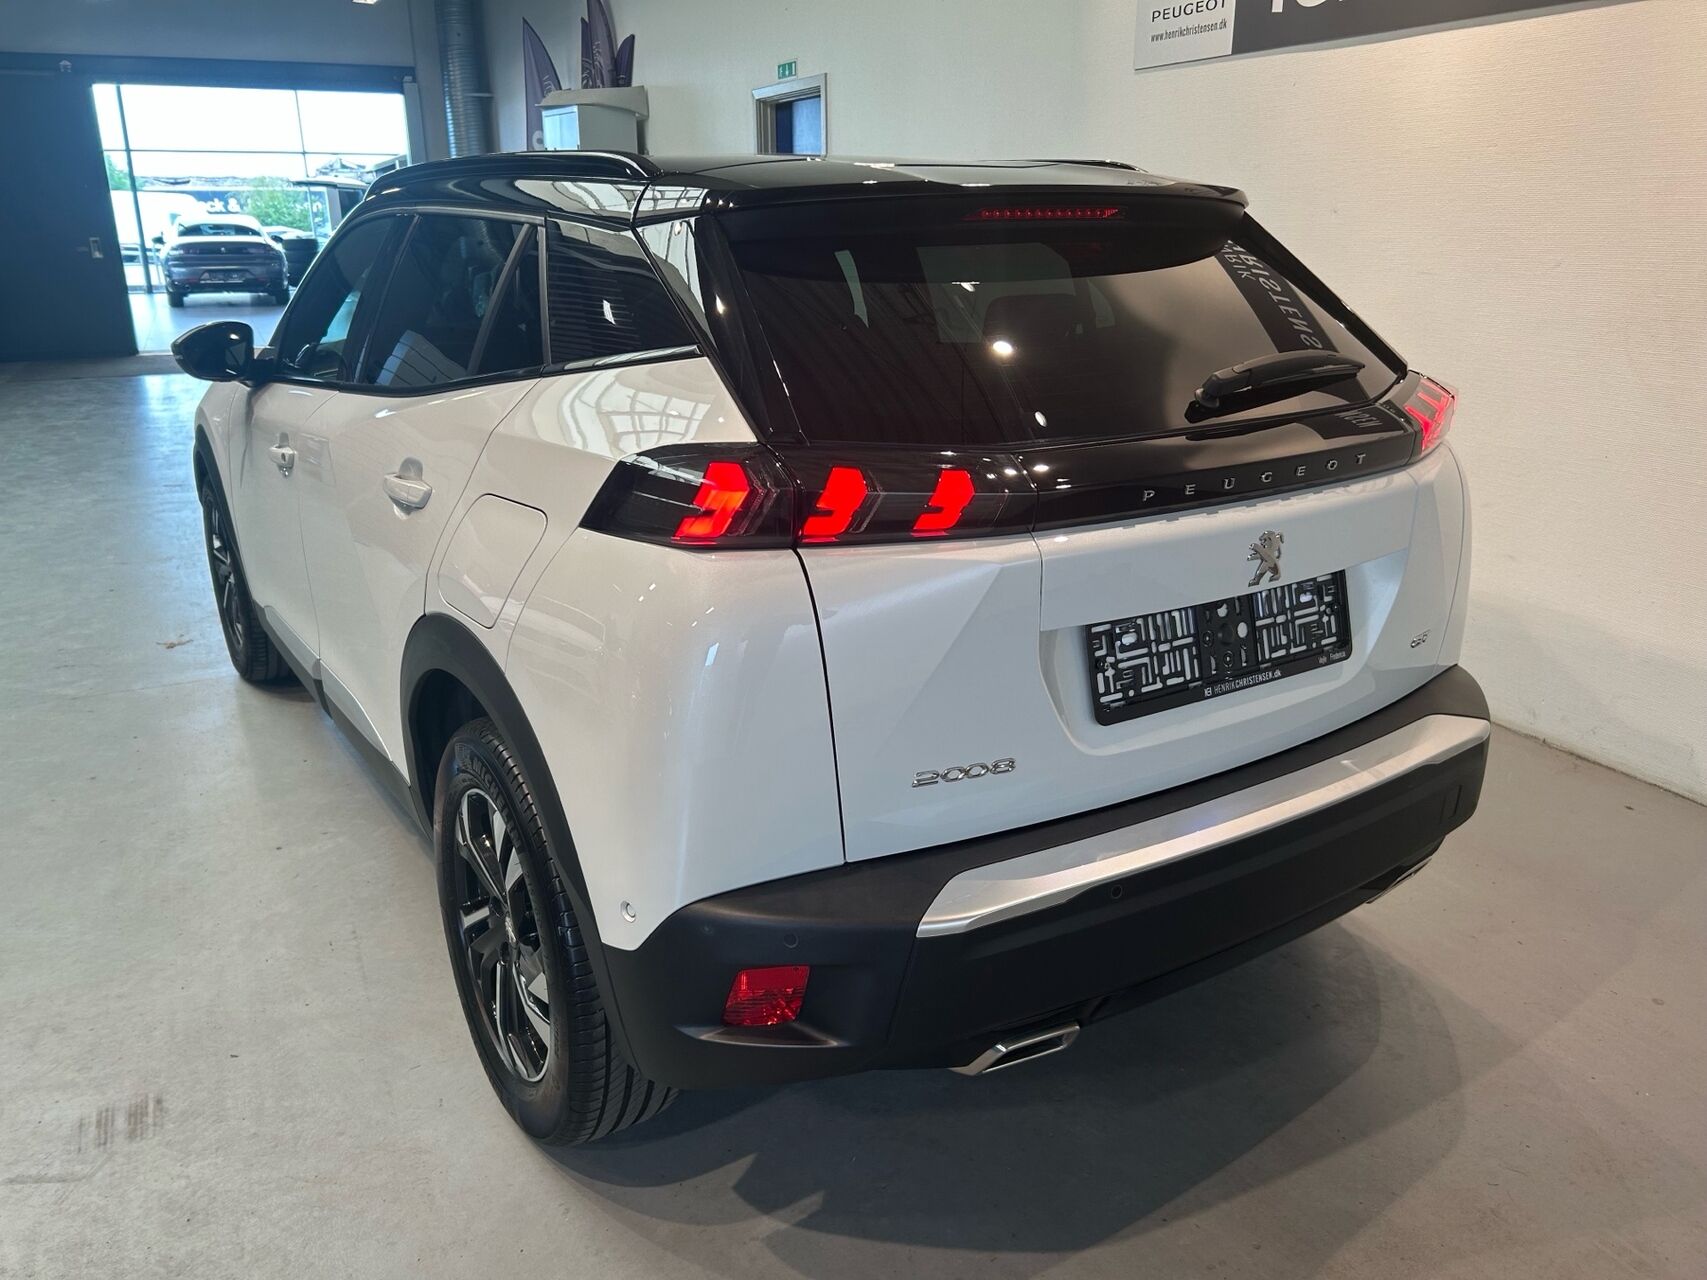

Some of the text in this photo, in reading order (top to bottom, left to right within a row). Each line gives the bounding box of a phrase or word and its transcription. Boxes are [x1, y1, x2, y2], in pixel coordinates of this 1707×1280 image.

[1150, 19, 1227, 42] www.henrikchristensen.dk
[1142, 453, 1367, 502] PEUGEOT
[911, 757, 1016, 788] 2008
